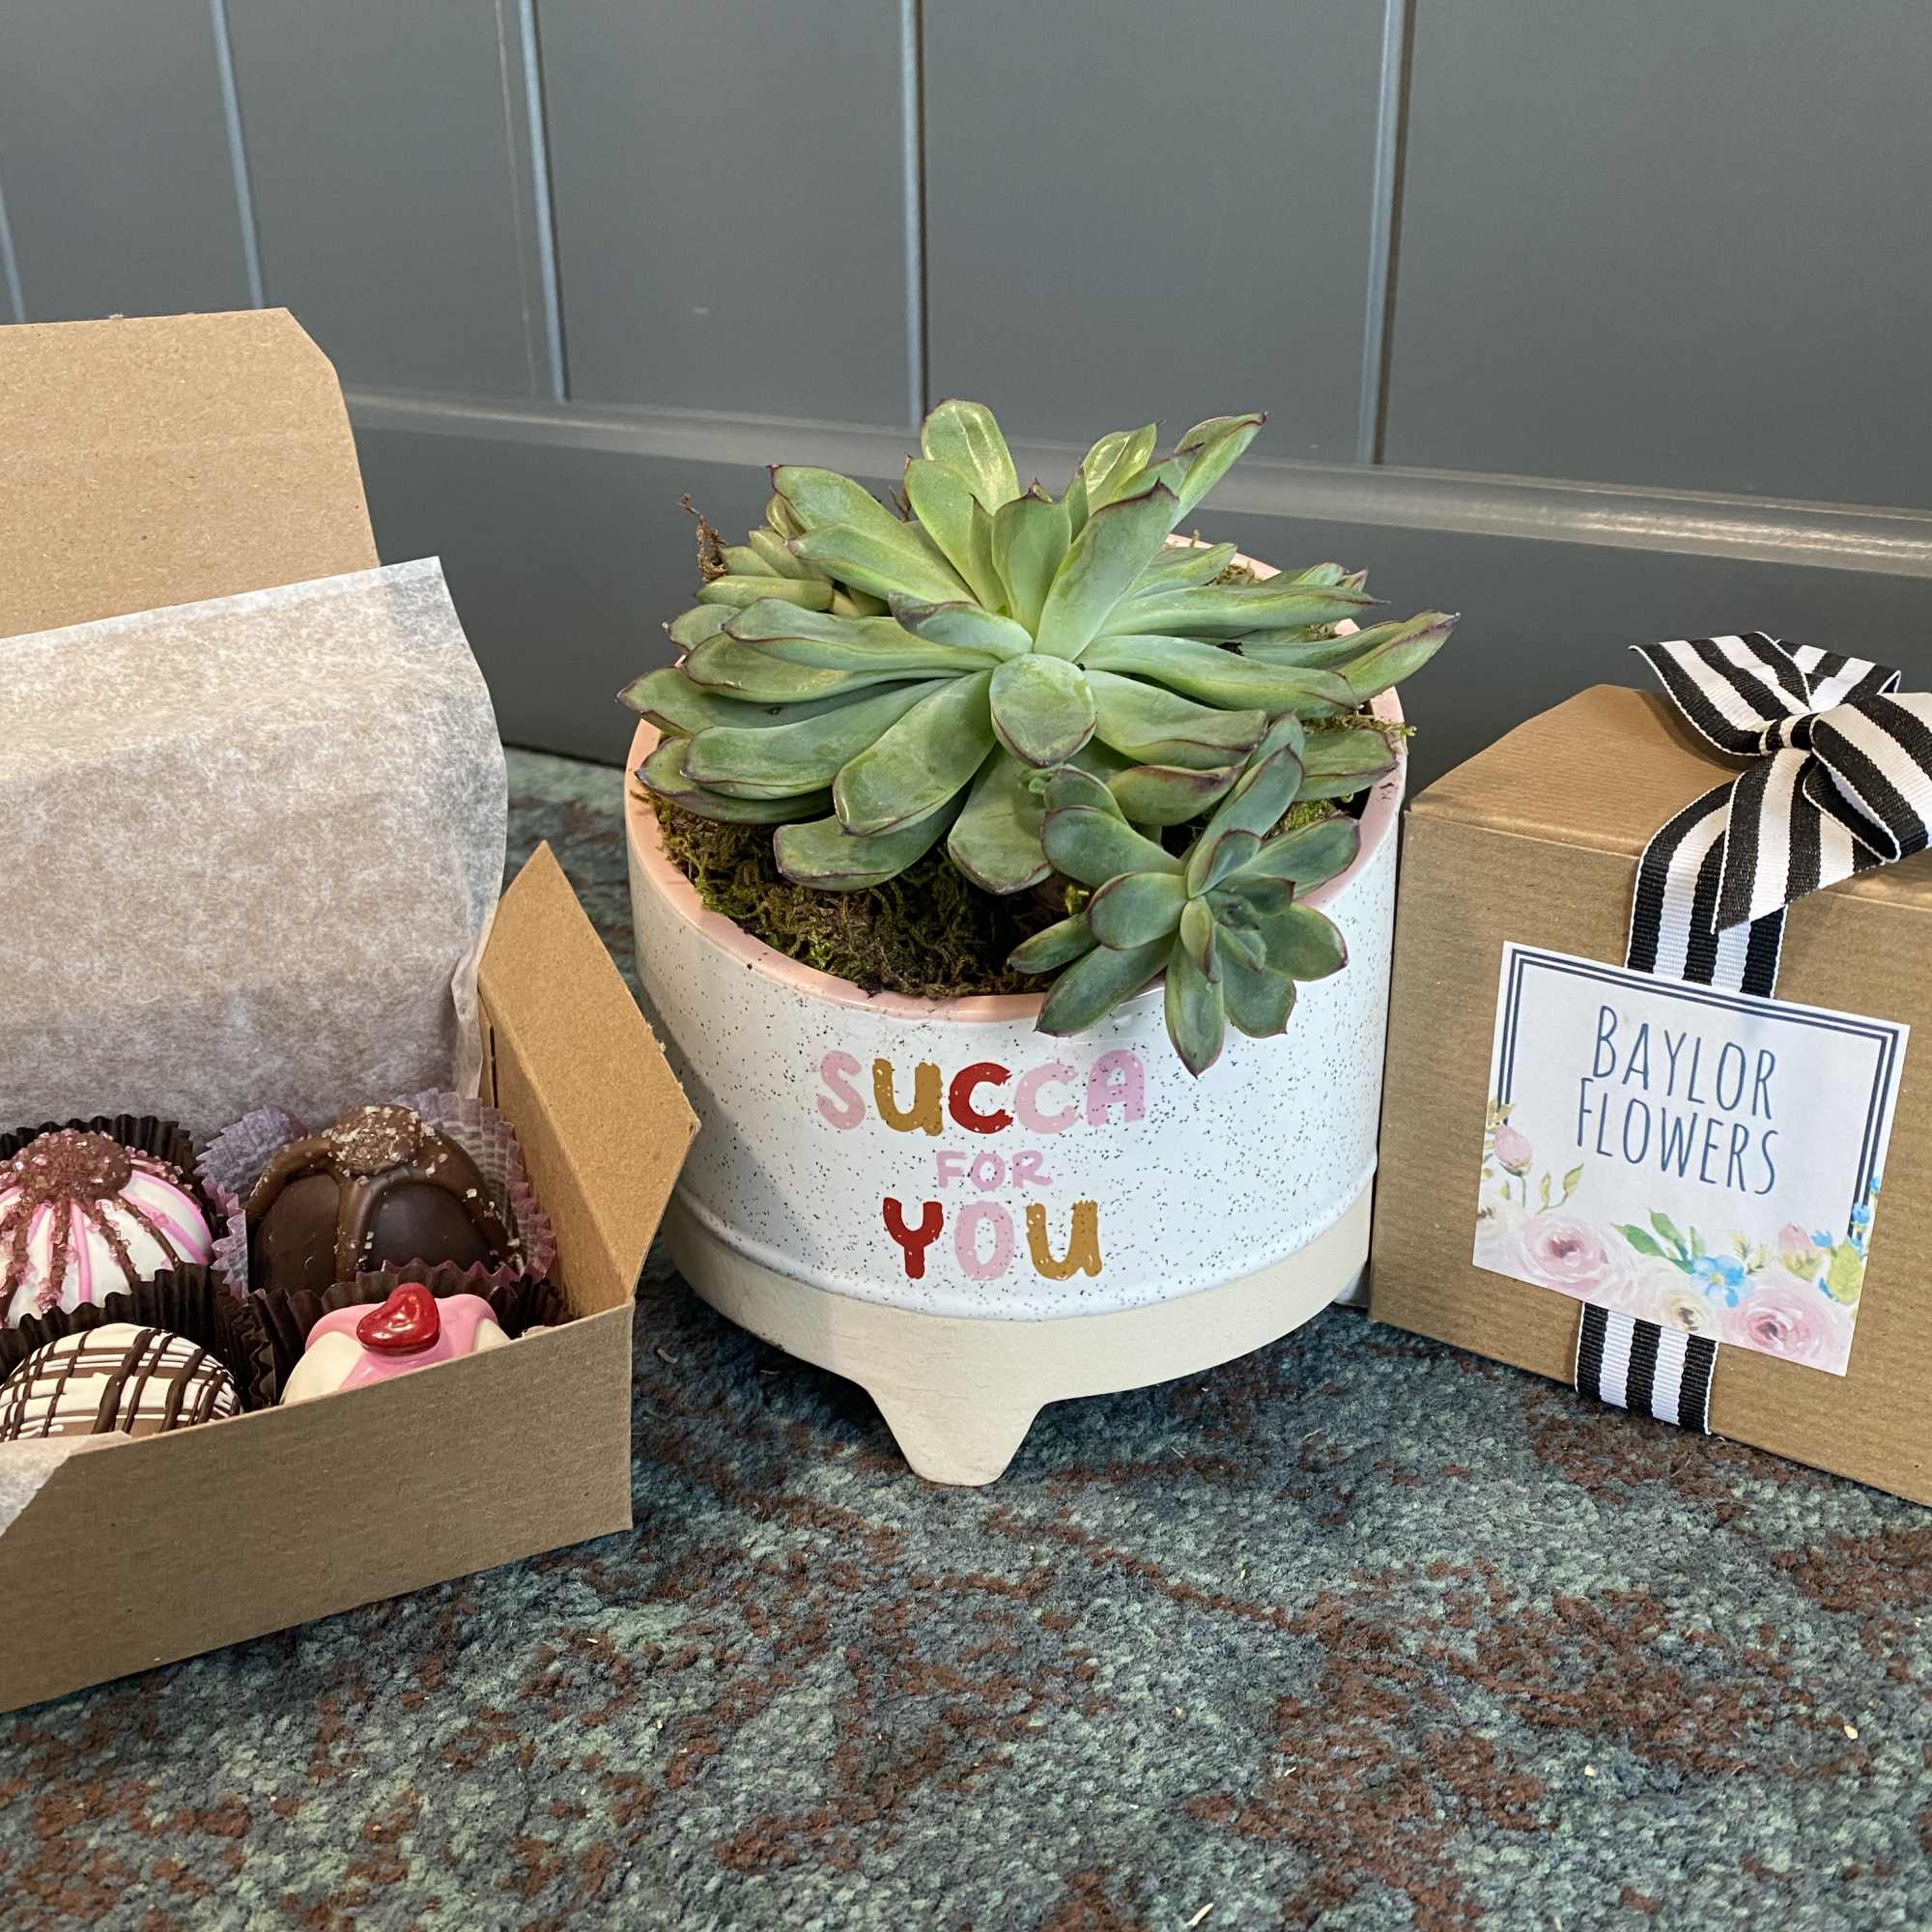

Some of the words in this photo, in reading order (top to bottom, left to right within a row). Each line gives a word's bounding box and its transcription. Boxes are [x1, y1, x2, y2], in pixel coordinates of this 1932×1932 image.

[816, 1050, 1146, 1136] SUCCA
[1593, 1005, 1776, 1120] BAYLOR
[935, 1150, 1053, 1191] FOR
[1577, 1077, 1778, 1194] FLOWERS
[883, 1197, 1102, 1281] YOU
